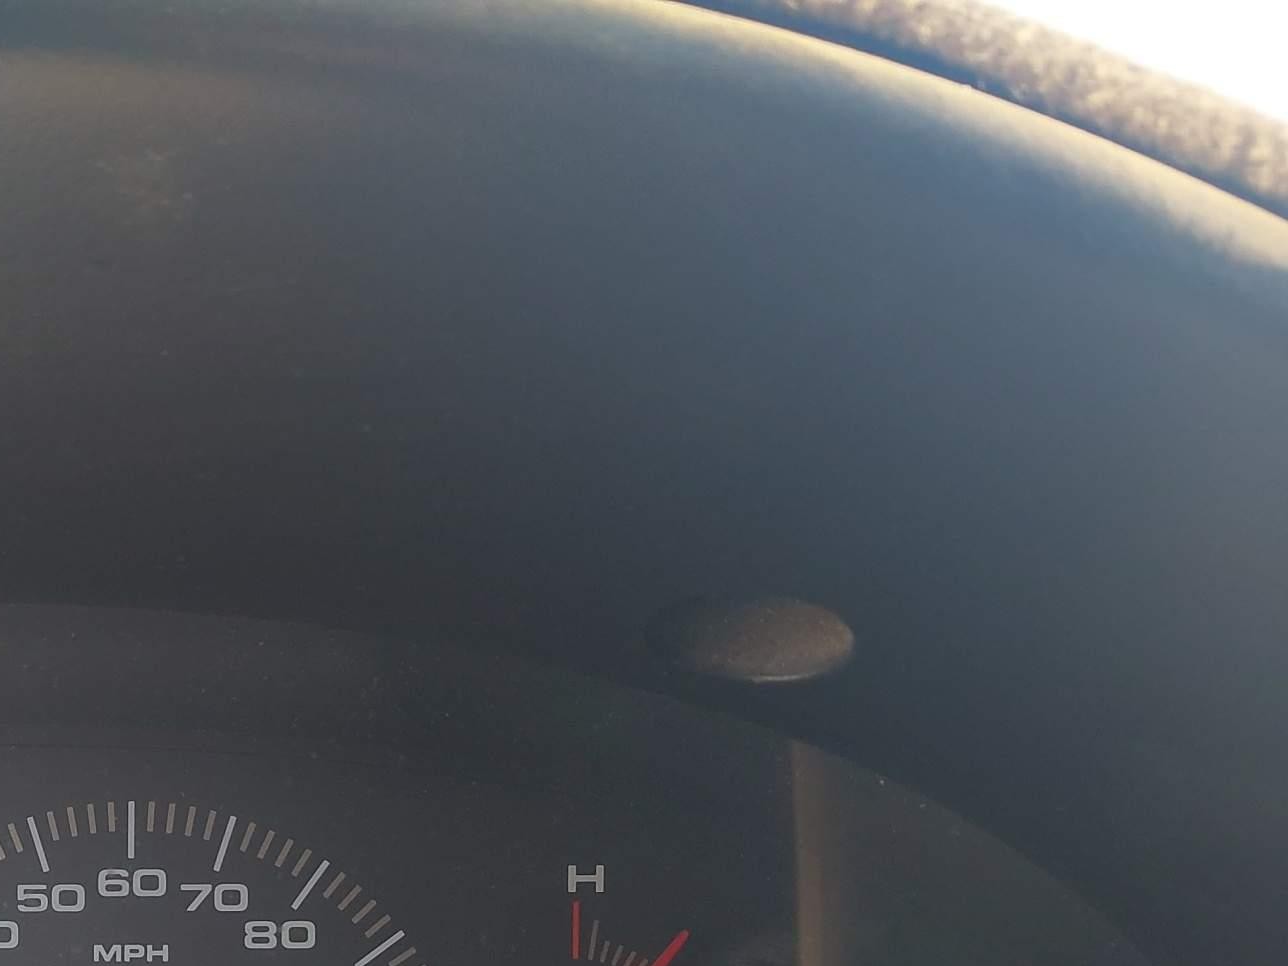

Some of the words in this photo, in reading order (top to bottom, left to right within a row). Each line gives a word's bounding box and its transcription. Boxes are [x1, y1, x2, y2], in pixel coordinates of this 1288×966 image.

[98, 868, 166, 897] 60
[568, 865, 604, 892] H
[17, 883, 86, 912] 50
[180, 883, 249, 912] 70
[244, 920, 316, 949] 80
[93, 944, 169, 962] MPH
